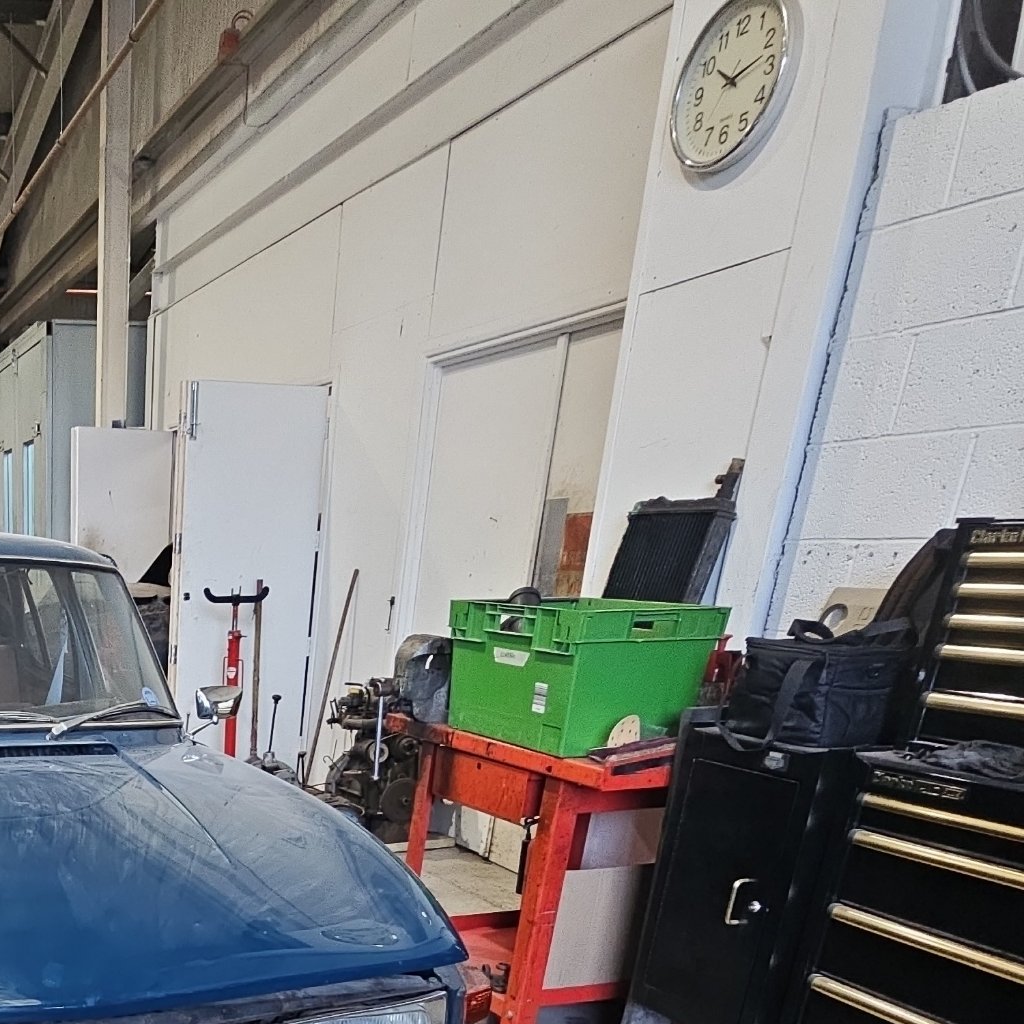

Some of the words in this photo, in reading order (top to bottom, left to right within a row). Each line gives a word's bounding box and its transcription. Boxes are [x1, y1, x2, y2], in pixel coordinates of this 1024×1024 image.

[736, 14, 752, 39] 12
[760, 11, 767, 31] 1
[718, 30, 730, 53] 11
[763, 27, 776, 50] 2
[701, 55, 716, 78] 10
[763, 54, 776, 76] 3
[694, 87, 705, 107] 9
[754, 85, 766, 105] 4
[693, 111, 704, 132] 8
[738, 111, 749, 132] 5
[704, 126, 715, 147] 7
[718, 124, 729, 145] 6
